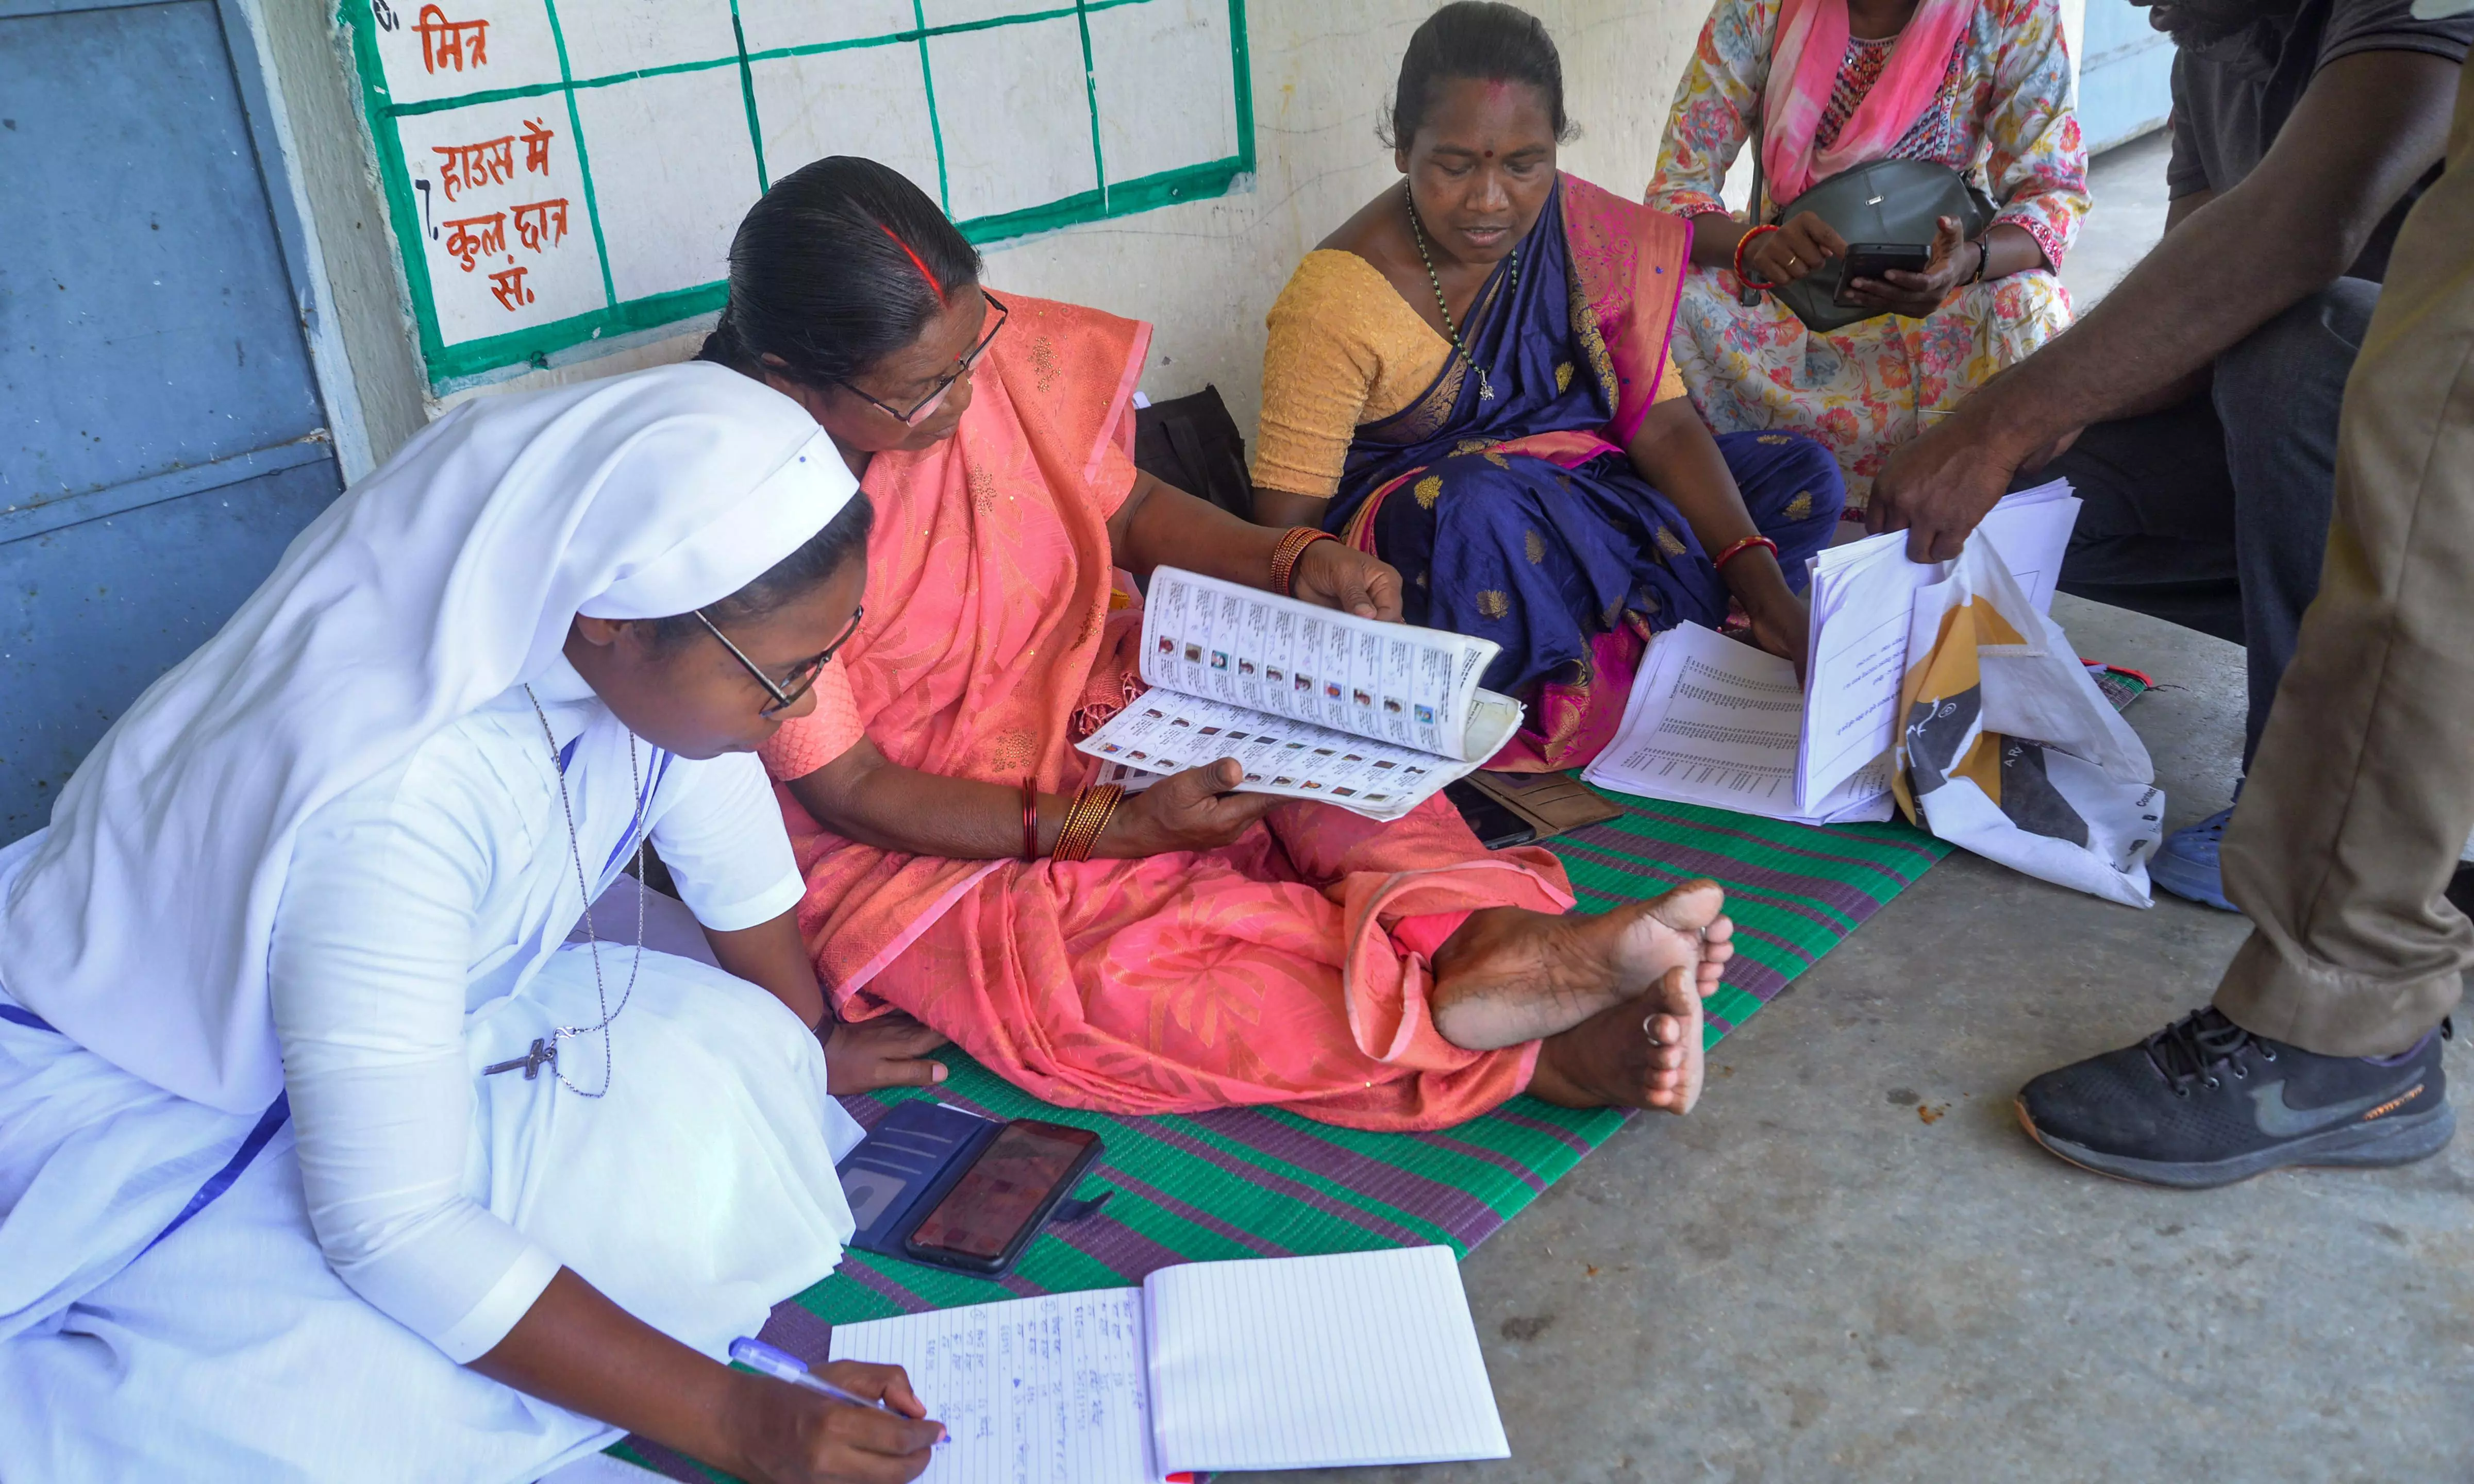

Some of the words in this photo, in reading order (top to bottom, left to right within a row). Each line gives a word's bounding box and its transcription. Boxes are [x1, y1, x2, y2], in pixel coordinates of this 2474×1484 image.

[412, 4, 489, 74] मित्र
[432, 136, 515, 201] हाउस
[520, 117, 554, 176] में
[442, 212, 506, 272] कुल
[510, 198, 569, 253] छात्र
